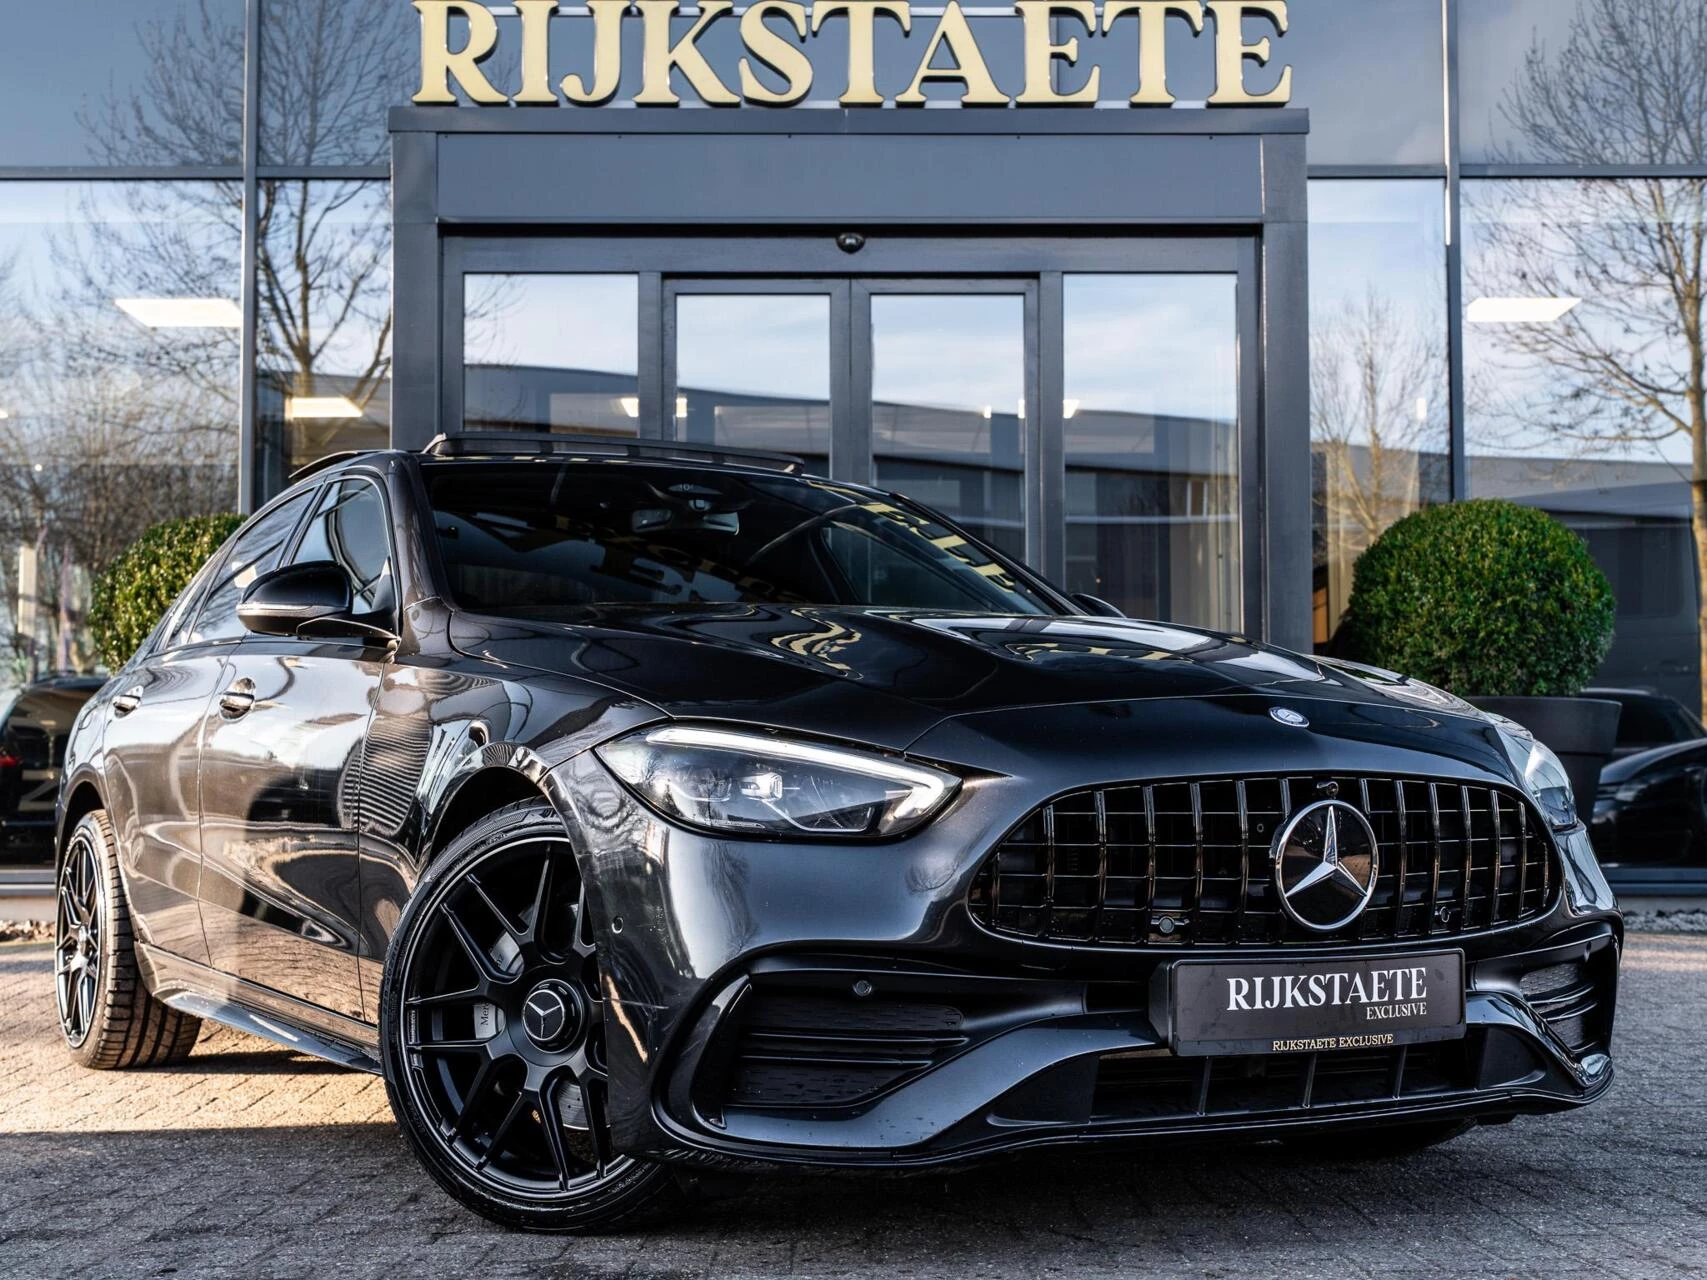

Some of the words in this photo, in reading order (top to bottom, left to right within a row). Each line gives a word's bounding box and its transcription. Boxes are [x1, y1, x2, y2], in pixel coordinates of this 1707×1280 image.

[412, 0, 1293, 106] RIJKSTAETE
[1227, 967, 1427, 1011] RIJKSTAETE
[1366, 1002, 1427, 1020] EXCLUSIVE
[1272, 1038, 1337, 1052] RIJKSTAETE
[1339, 1034, 1393, 1048] EXCLUSIVE
